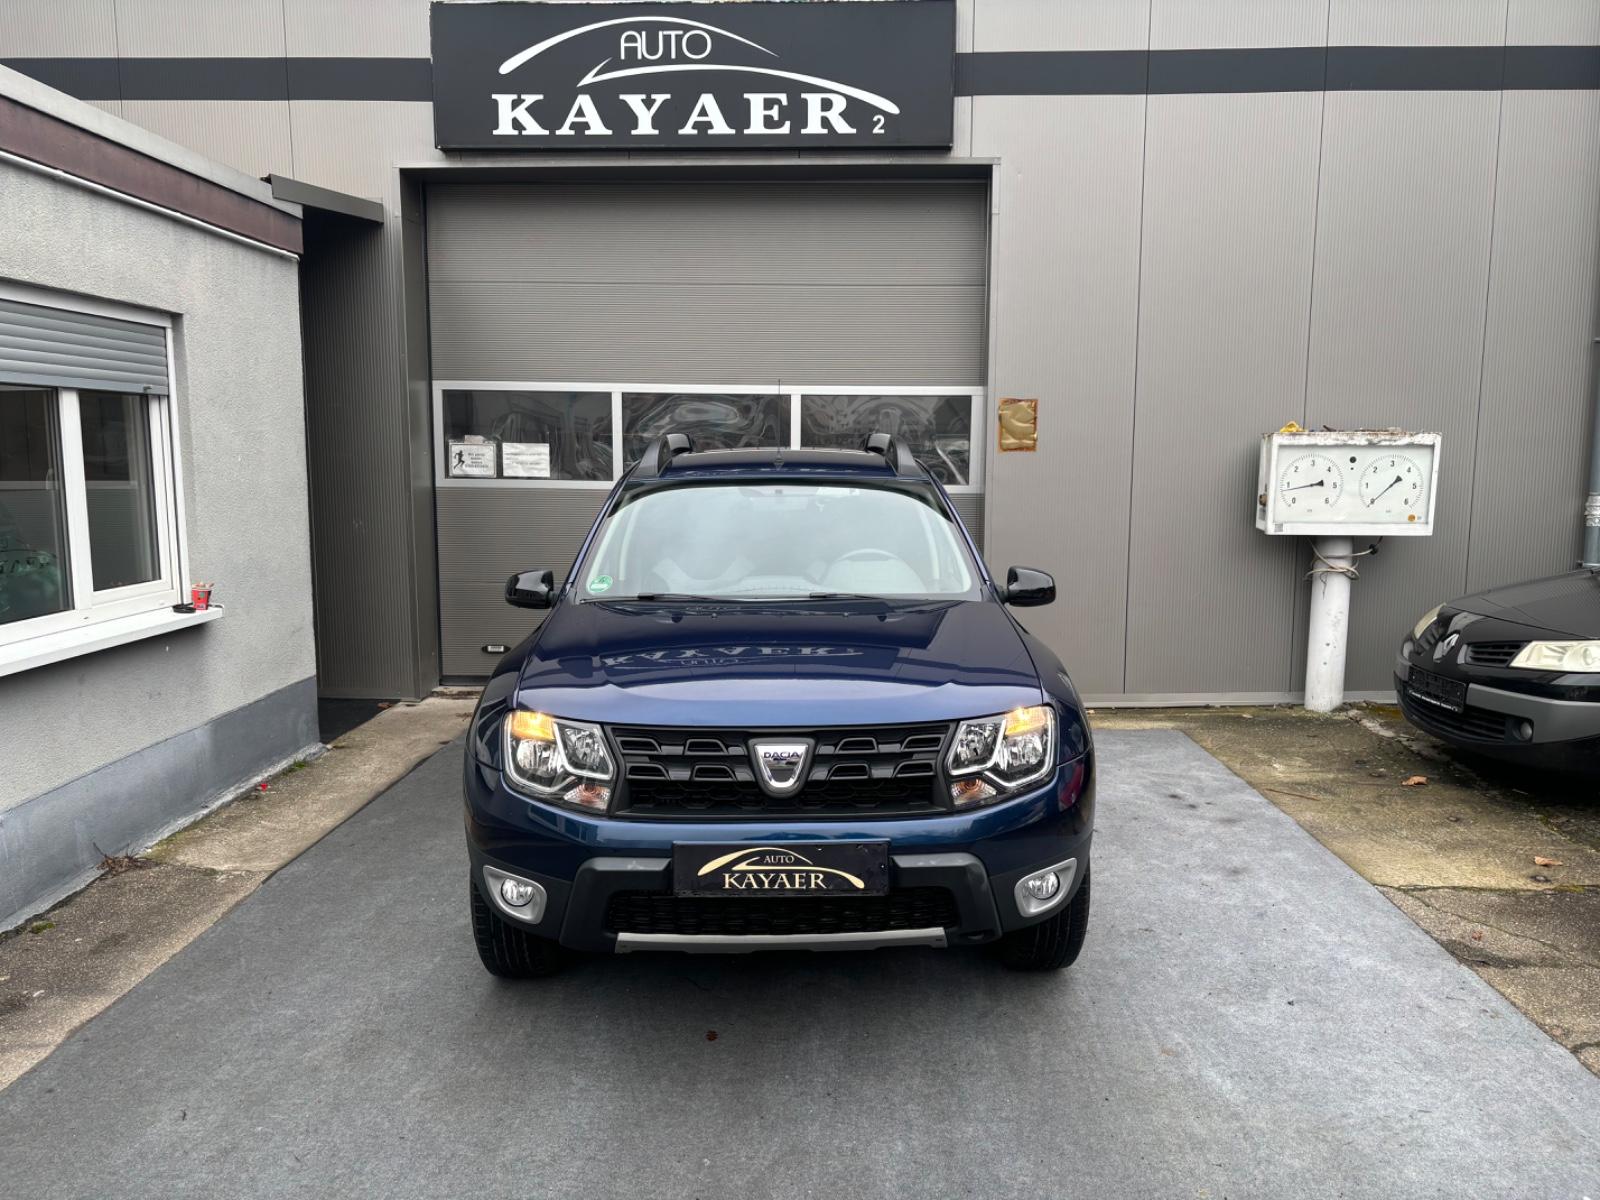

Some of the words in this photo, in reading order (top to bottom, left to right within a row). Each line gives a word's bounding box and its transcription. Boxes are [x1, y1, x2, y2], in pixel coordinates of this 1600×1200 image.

[620, 30, 712, 60] AUTO
[491, 92, 857, 136] KAYAER
[872, 115, 885, 134] 2
[1389, 460, 1396, 468] 3
[1293, 465, 1299, 473] 2
[1372, 466, 1378, 474] 2
[1332, 481, 1338, 489] 5
[1411, 482, 1417, 490] 5
[1291, 496, 1297, 505] 0
[1324, 497, 1330, 505] 6
[1403, 498, 1409, 506] 6
[763, 751, 800, 759] DACIA
[763, 855, 795, 864] AUTO
[722, 873, 827, 889] KAYAER
